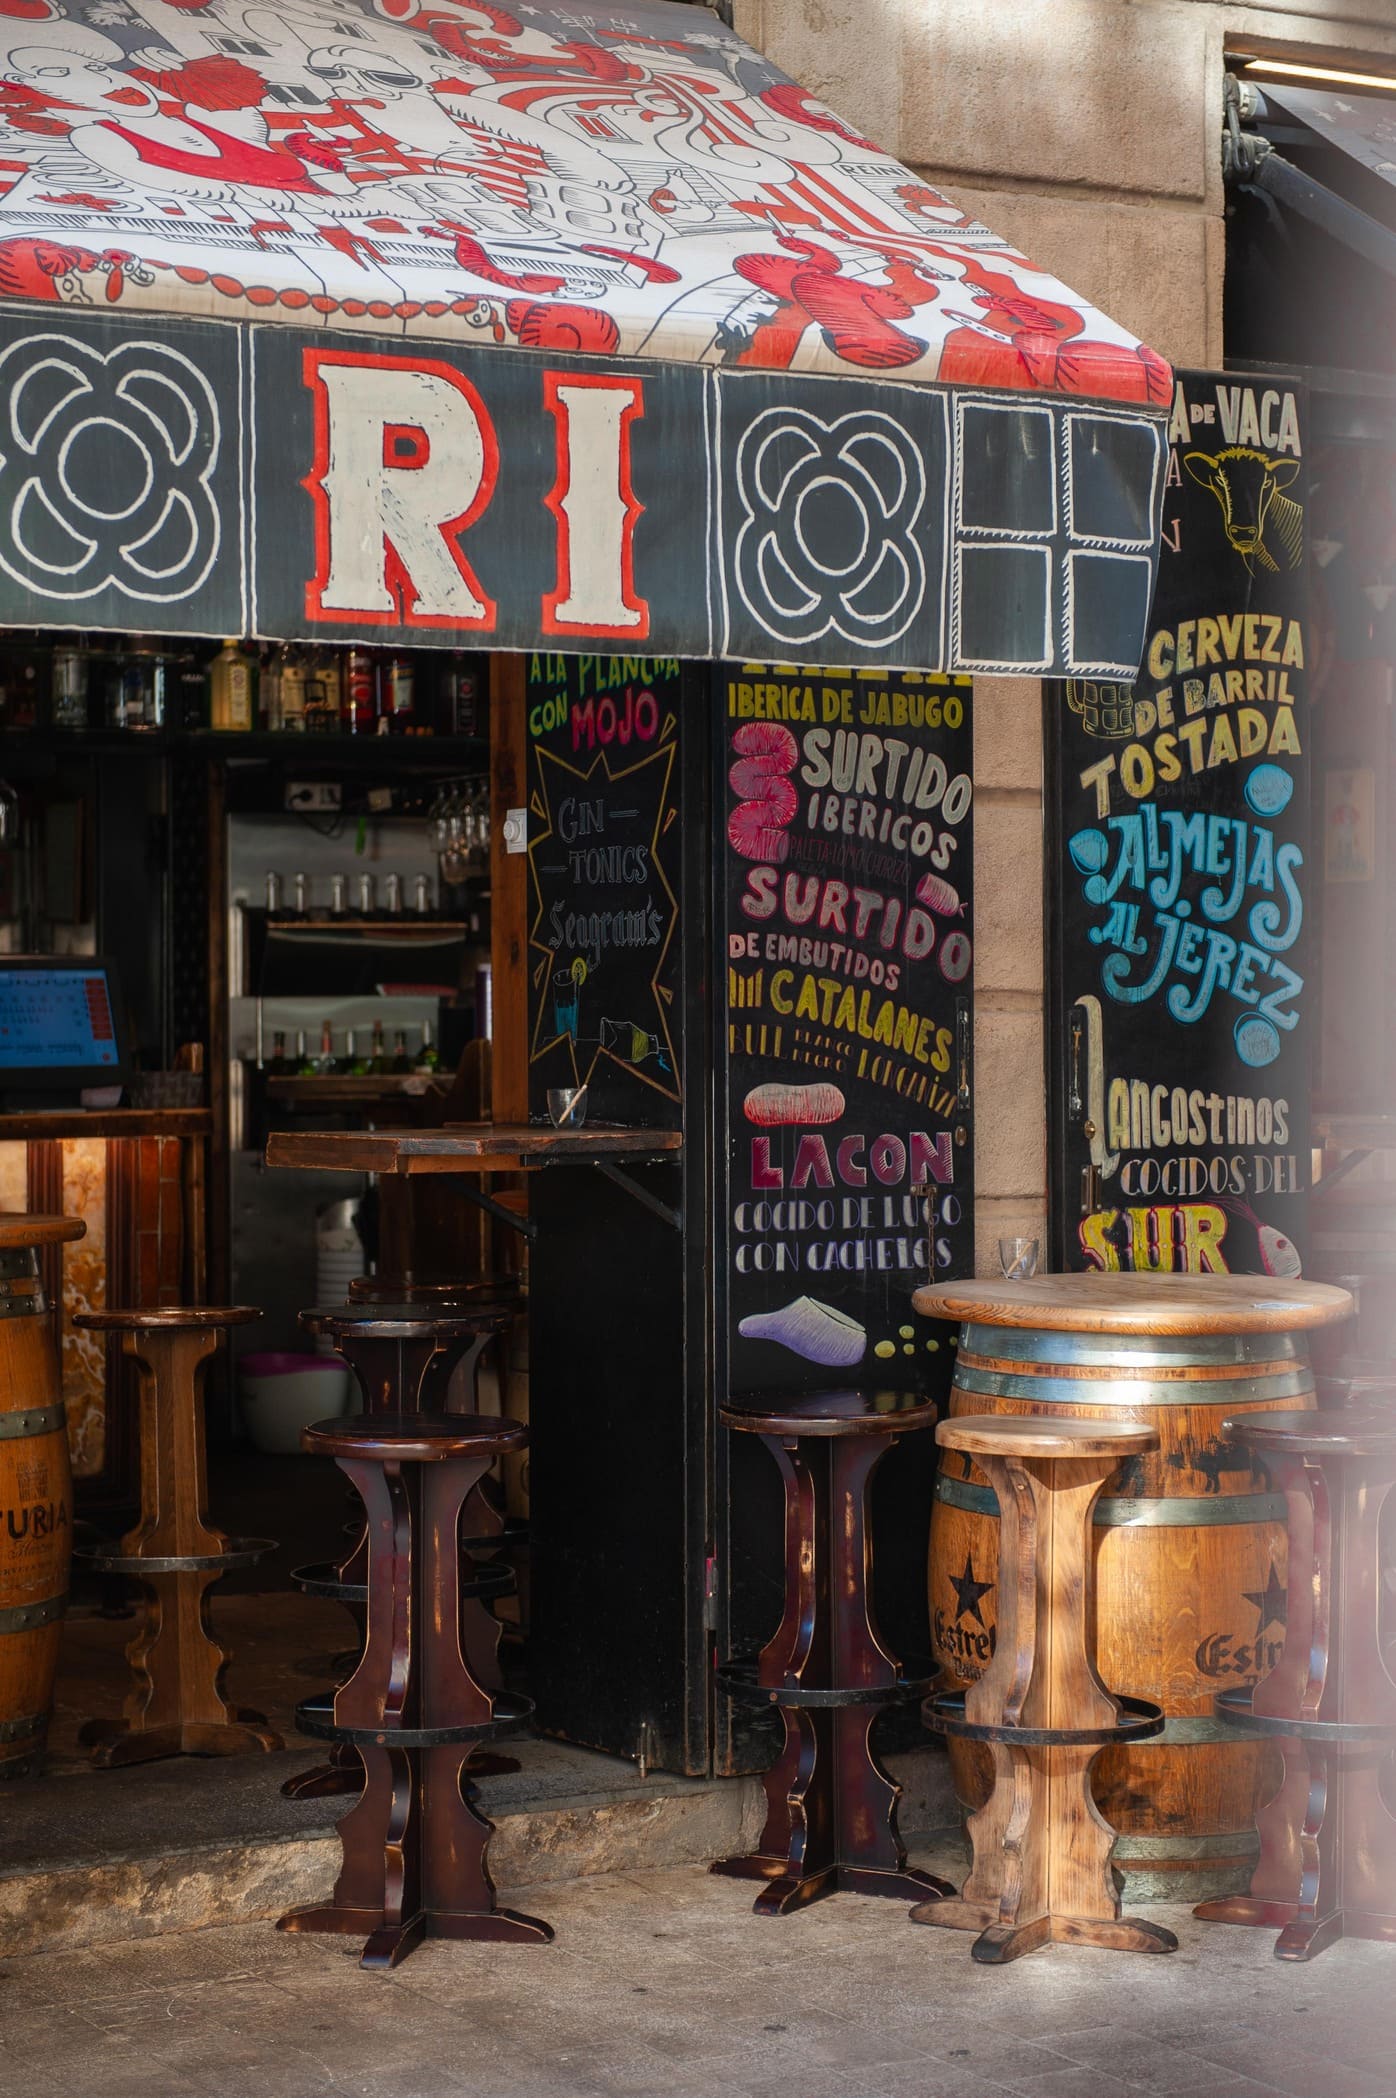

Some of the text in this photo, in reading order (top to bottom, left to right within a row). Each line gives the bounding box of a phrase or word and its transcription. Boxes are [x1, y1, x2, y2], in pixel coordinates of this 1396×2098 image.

[1190, 404, 1216, 424] DE
[1216, 385, 1302, 457] VACA
[530, 653, 680, 697] A LA PLANCHA
[1148, 614, 1304, 680] CERVEZA
[530, 690, 567, 736] CON
[571, 687, 658, 752] MOJO
[728, 682, 963, 728] IBERICA DE JABUGO
[1134, 670, 1295, 737] DE BARRIL
[801, 728, 972, 825] SURTIDO
[1080, 705, 1302, 819] TOSTADA
[558, 797, 605, 843] GIN
[808, 793, 957, 869] IBERICOS
[569, 844, 648, 885] TONICS
[1083, 803, 1304, 952] ALMEJAS
[549, 895, 664, 972] Seagram's
[742, 865, 973, 984] SURTIDO
[728, 934, 901, 990] DE EMBUTIDOS
[1088, 899, 1304, 1031] AL JEREZ
[770, 968, 954, 1073] CATALANES
[751, 1132, 954, 1189] LACON
[1120, 1155, 1304, 1196] COCIDOS DEL
[734, 1194, 961, 1233] COCIDO DE LUGO
[1078, 1202, 1230, 1273] SUR
[736, 1237, 952, 1273] CON CACHELOS
[0, 1500, 67, 1540] URIA
